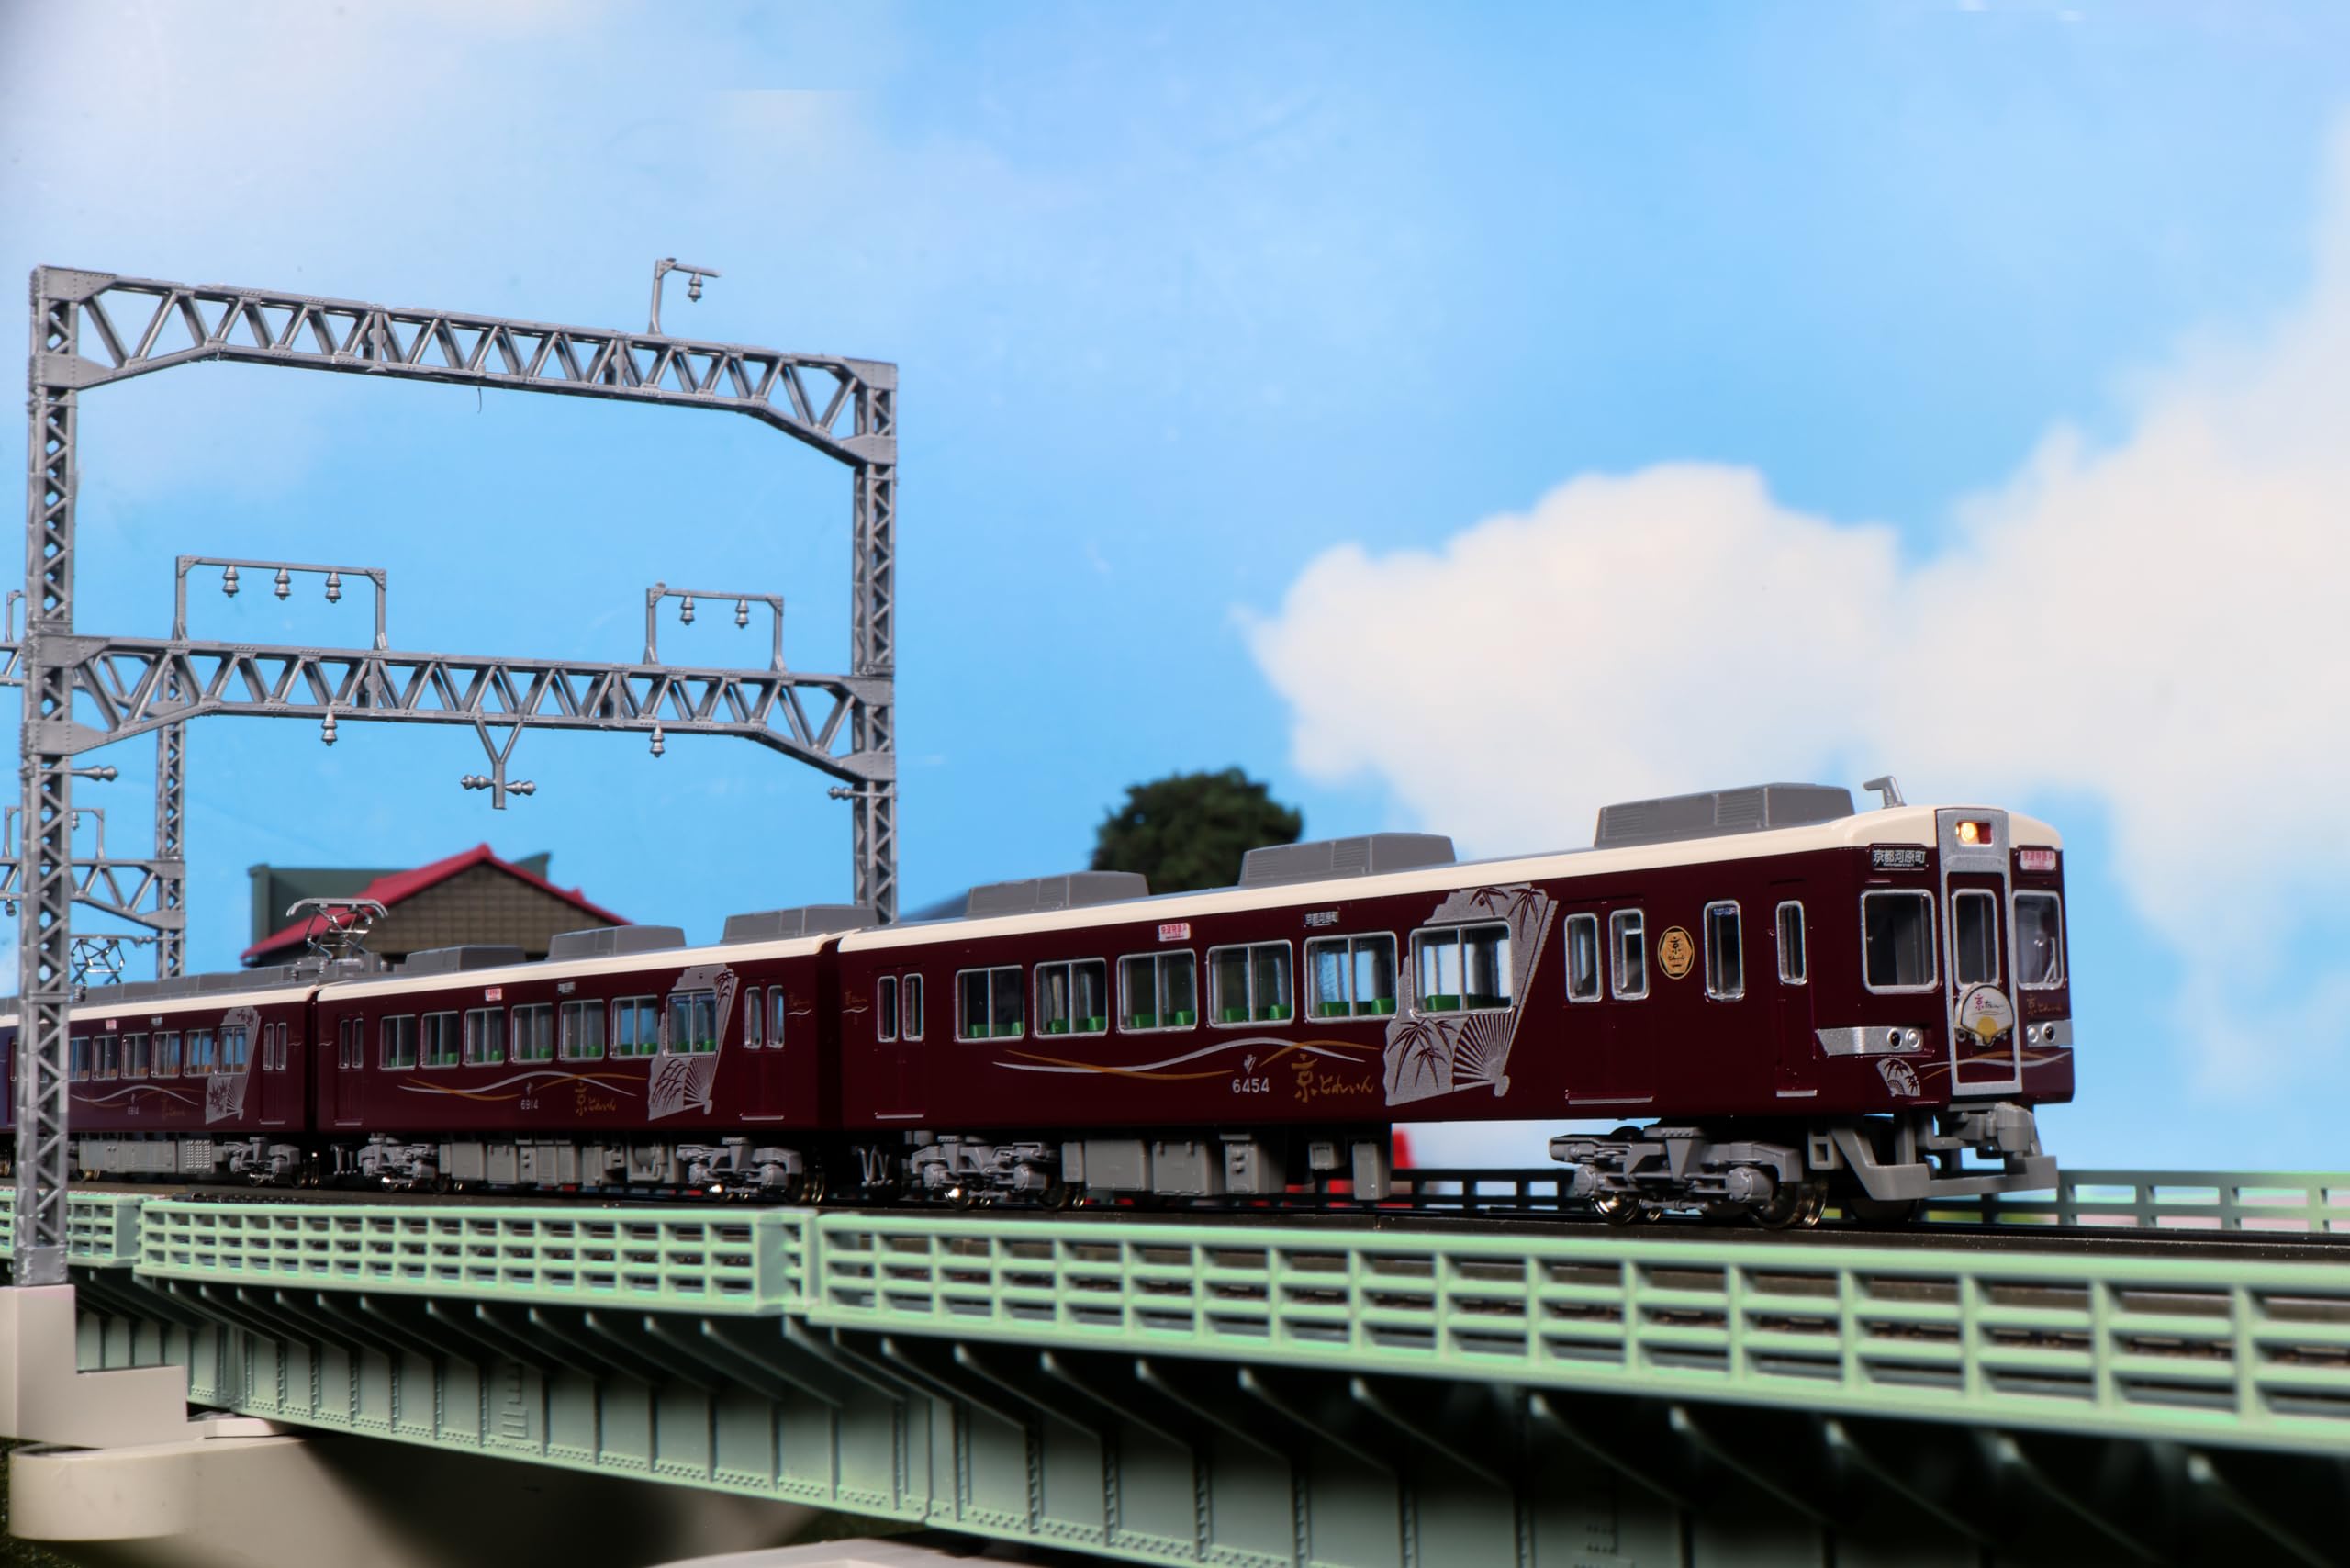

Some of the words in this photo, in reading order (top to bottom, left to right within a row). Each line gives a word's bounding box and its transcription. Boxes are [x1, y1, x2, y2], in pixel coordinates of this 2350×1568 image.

[1872, 849, 1926, 866] 京都河原町
[1232, 1077, 1270, 1093] 6454
